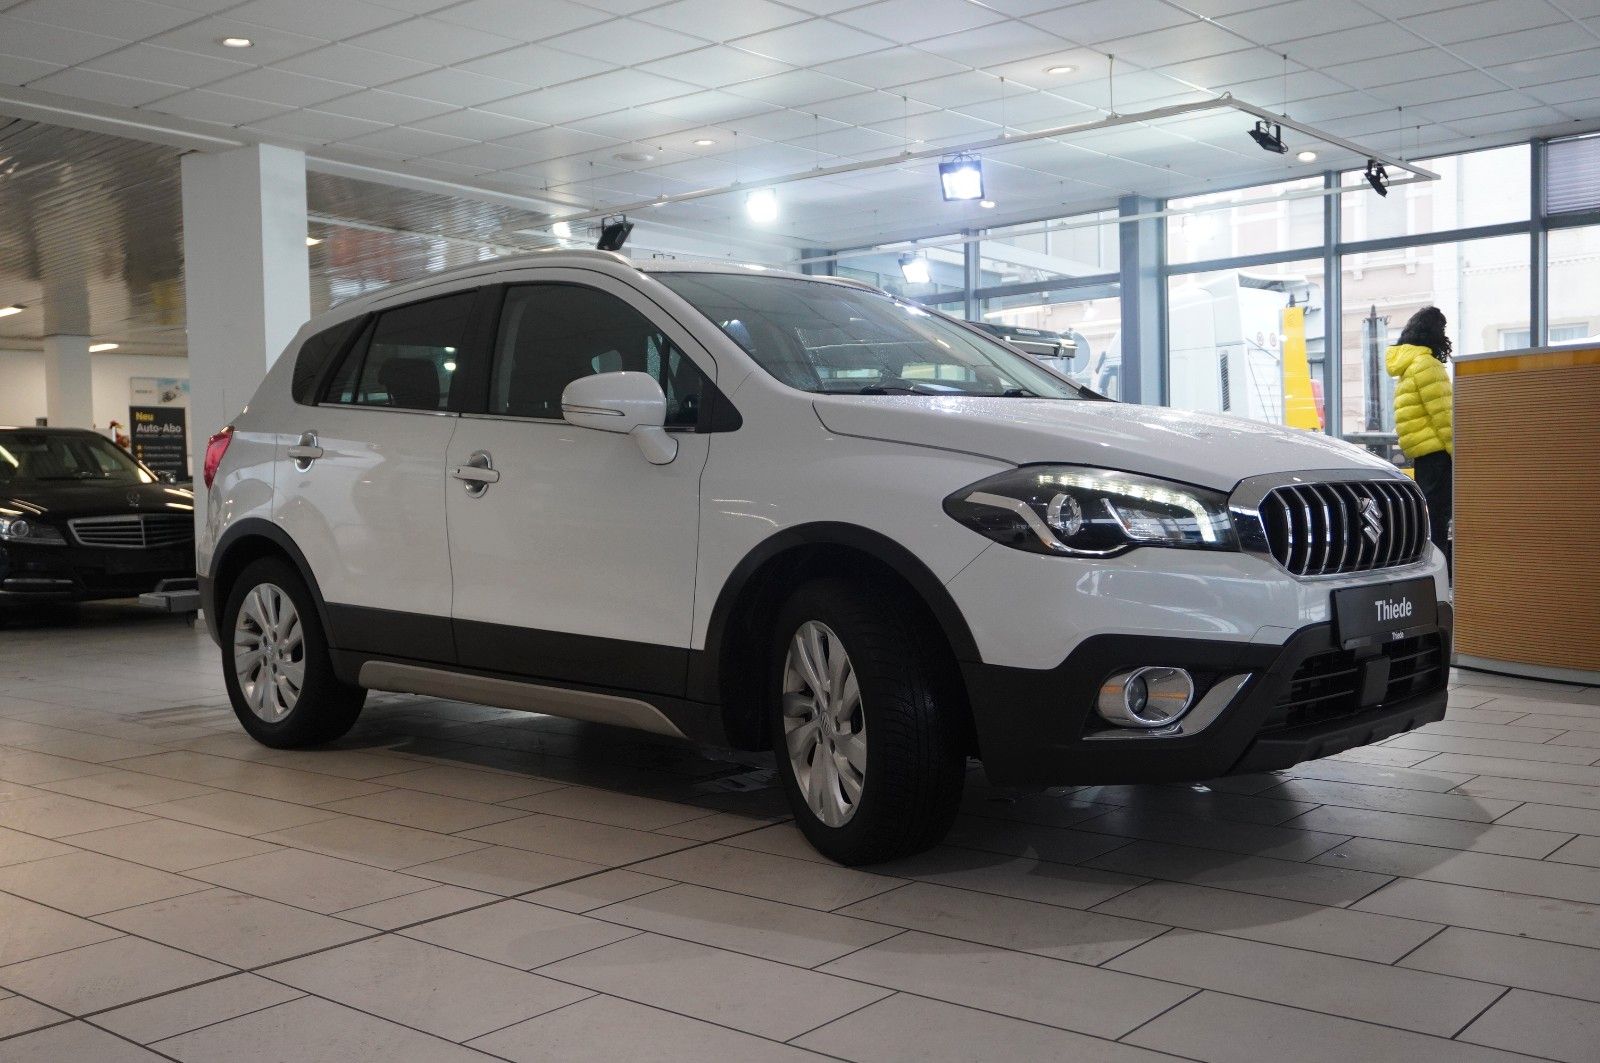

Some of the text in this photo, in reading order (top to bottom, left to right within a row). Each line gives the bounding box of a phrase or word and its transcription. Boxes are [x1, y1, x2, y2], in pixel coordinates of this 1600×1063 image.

[136, 412, 154, 421] Neu
[136, 424, 181, 433] Auto-Abo
[1375, 597, 1412, 621] Thiede
